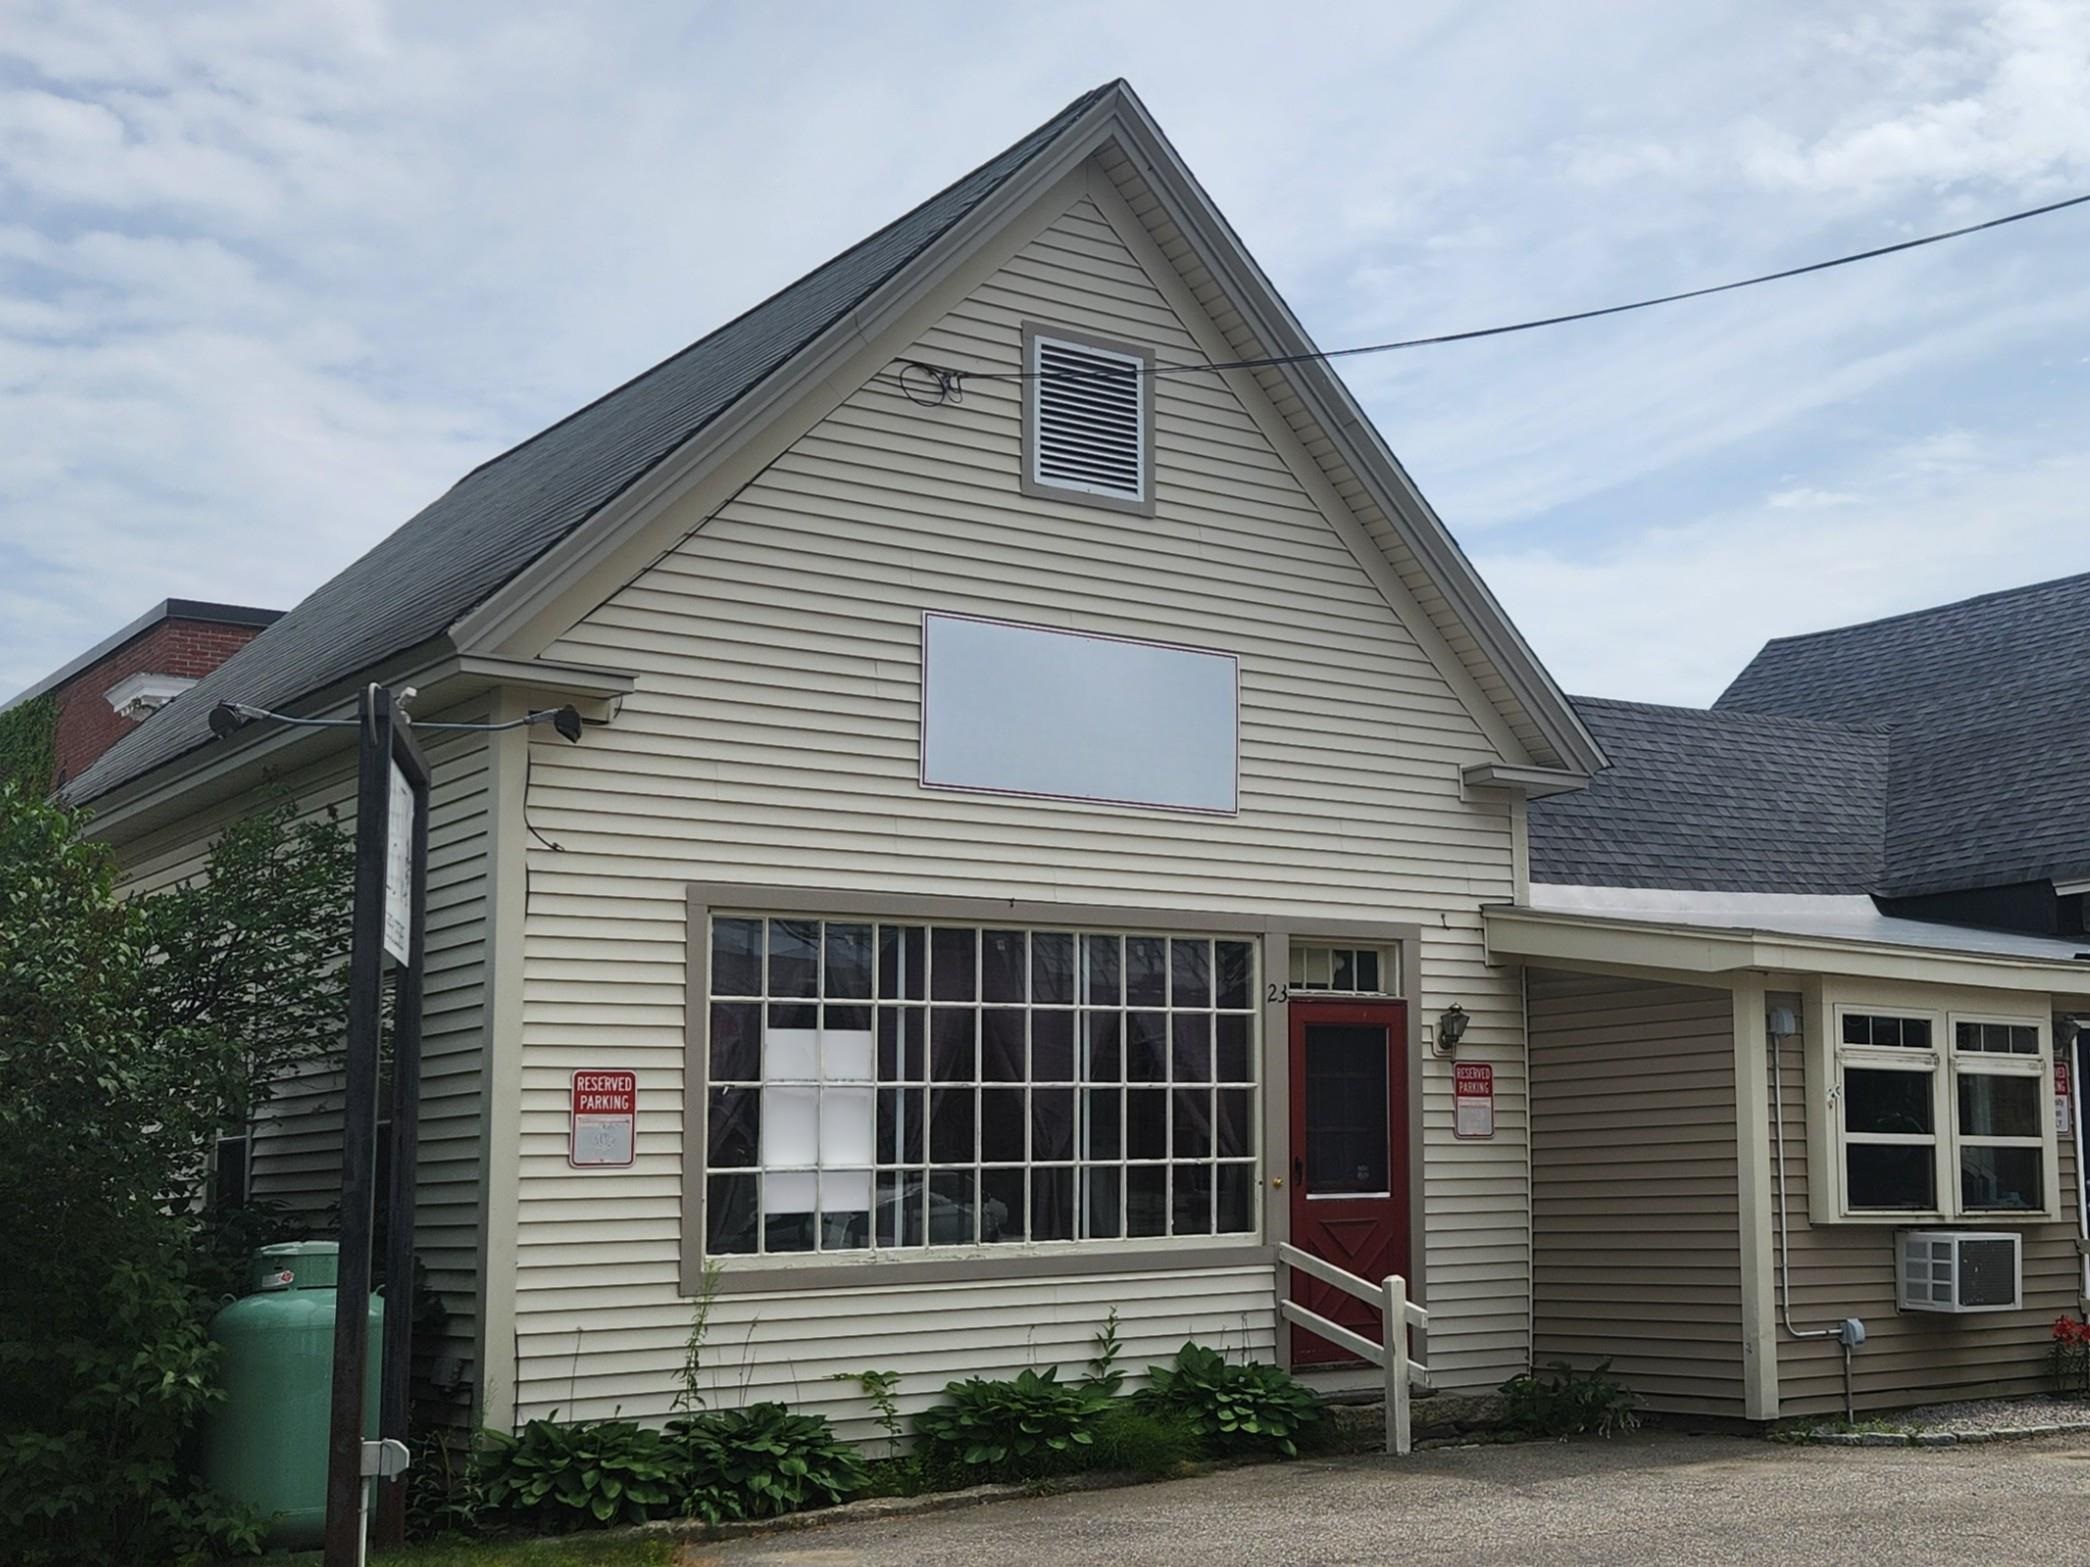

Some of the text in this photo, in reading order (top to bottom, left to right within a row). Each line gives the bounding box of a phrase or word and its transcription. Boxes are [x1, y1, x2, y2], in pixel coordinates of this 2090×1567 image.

[1268, 983, 1288, 1003] 23
[1456, 1066, 1491, 1080] RESERVED
[577, 1076, 632, 1092] RESERVED
[1459, 1081, 1489, 1094] PARKING
[580, 1094, 629, 1110] PARKING
